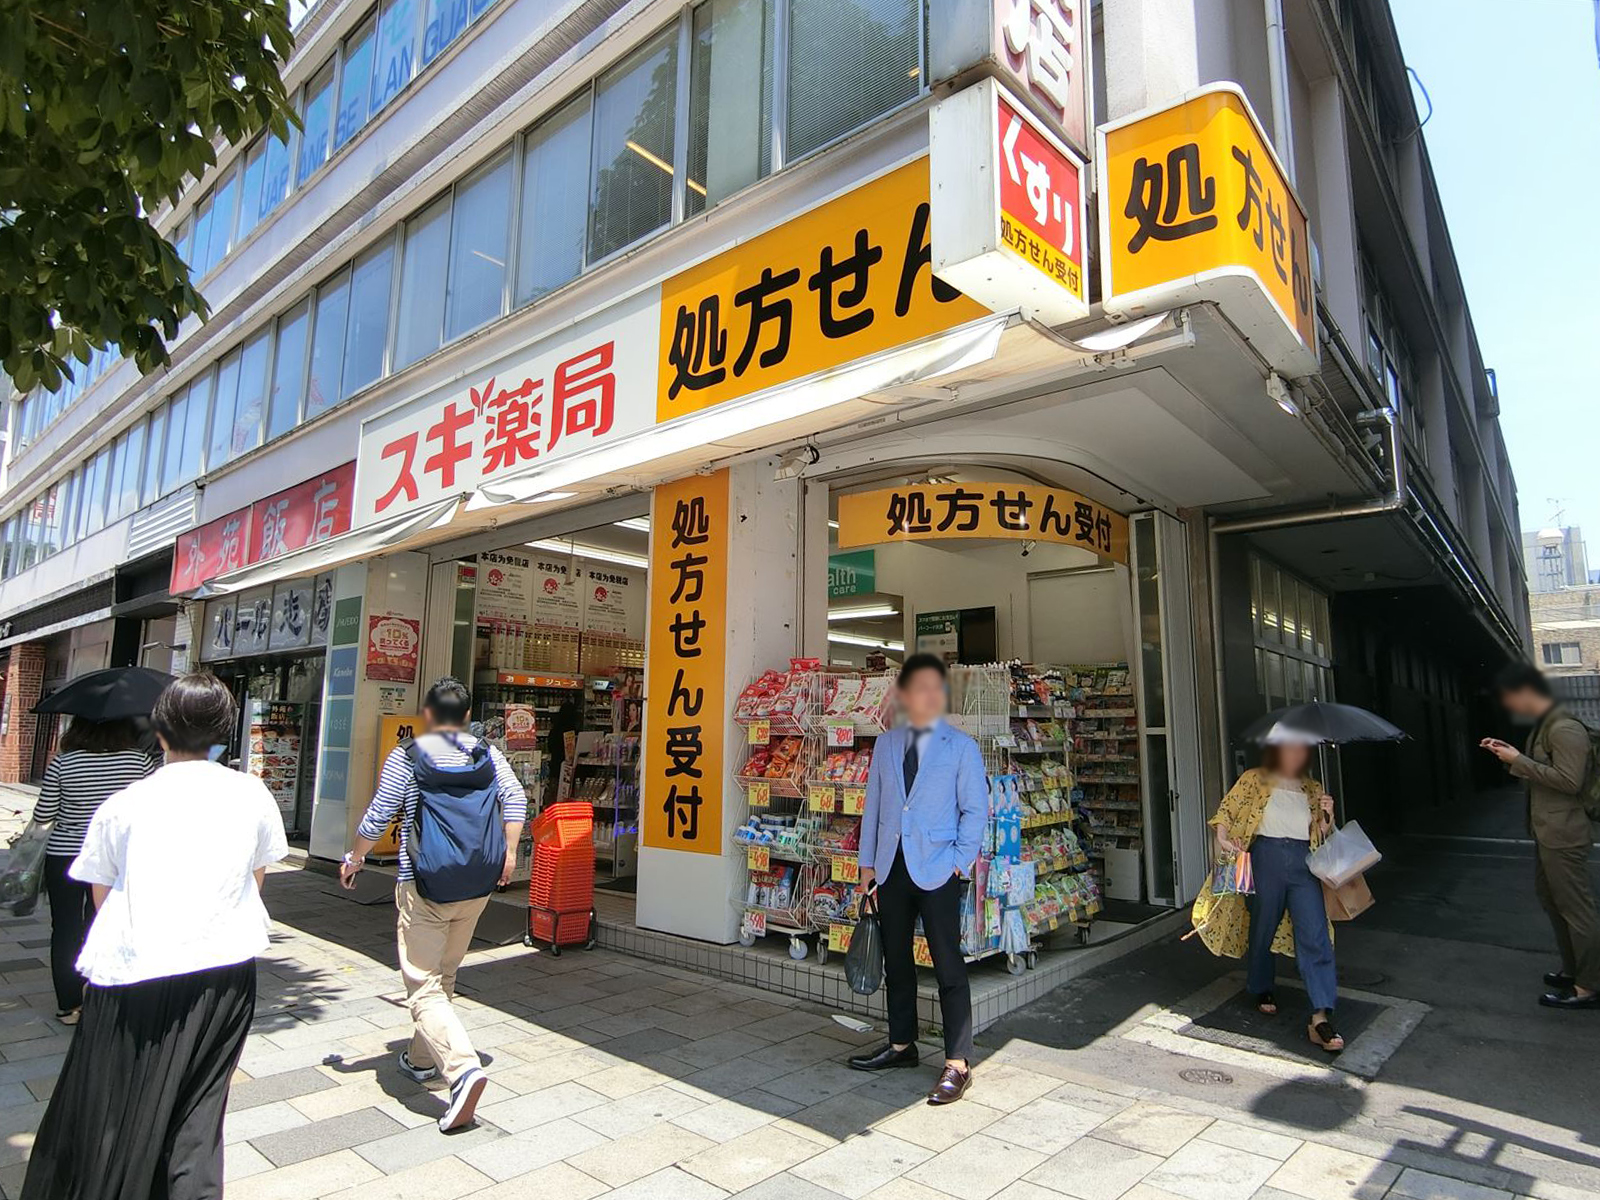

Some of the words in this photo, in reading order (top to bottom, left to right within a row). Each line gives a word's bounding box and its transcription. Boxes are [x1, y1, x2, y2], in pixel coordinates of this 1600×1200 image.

[370, 0, 488, 112] LANGUA
[1002, 113, 1073, 257] くすり
[1001, 214, 1079, 292] 処方せん受付
[1123, 143, 1308, 317] 処方せん
[375, 340, 616, 512] スギ薬局
[887, 488, 1112, 553] 処方せん受付
[833, 584, 856, 595] care
[546, 678, 578, 687] ジュース
[663, 496, 709, 840] 処方せん受付
[756, 788, 769, 804] 68
[820, 795, 833, 810] 68
